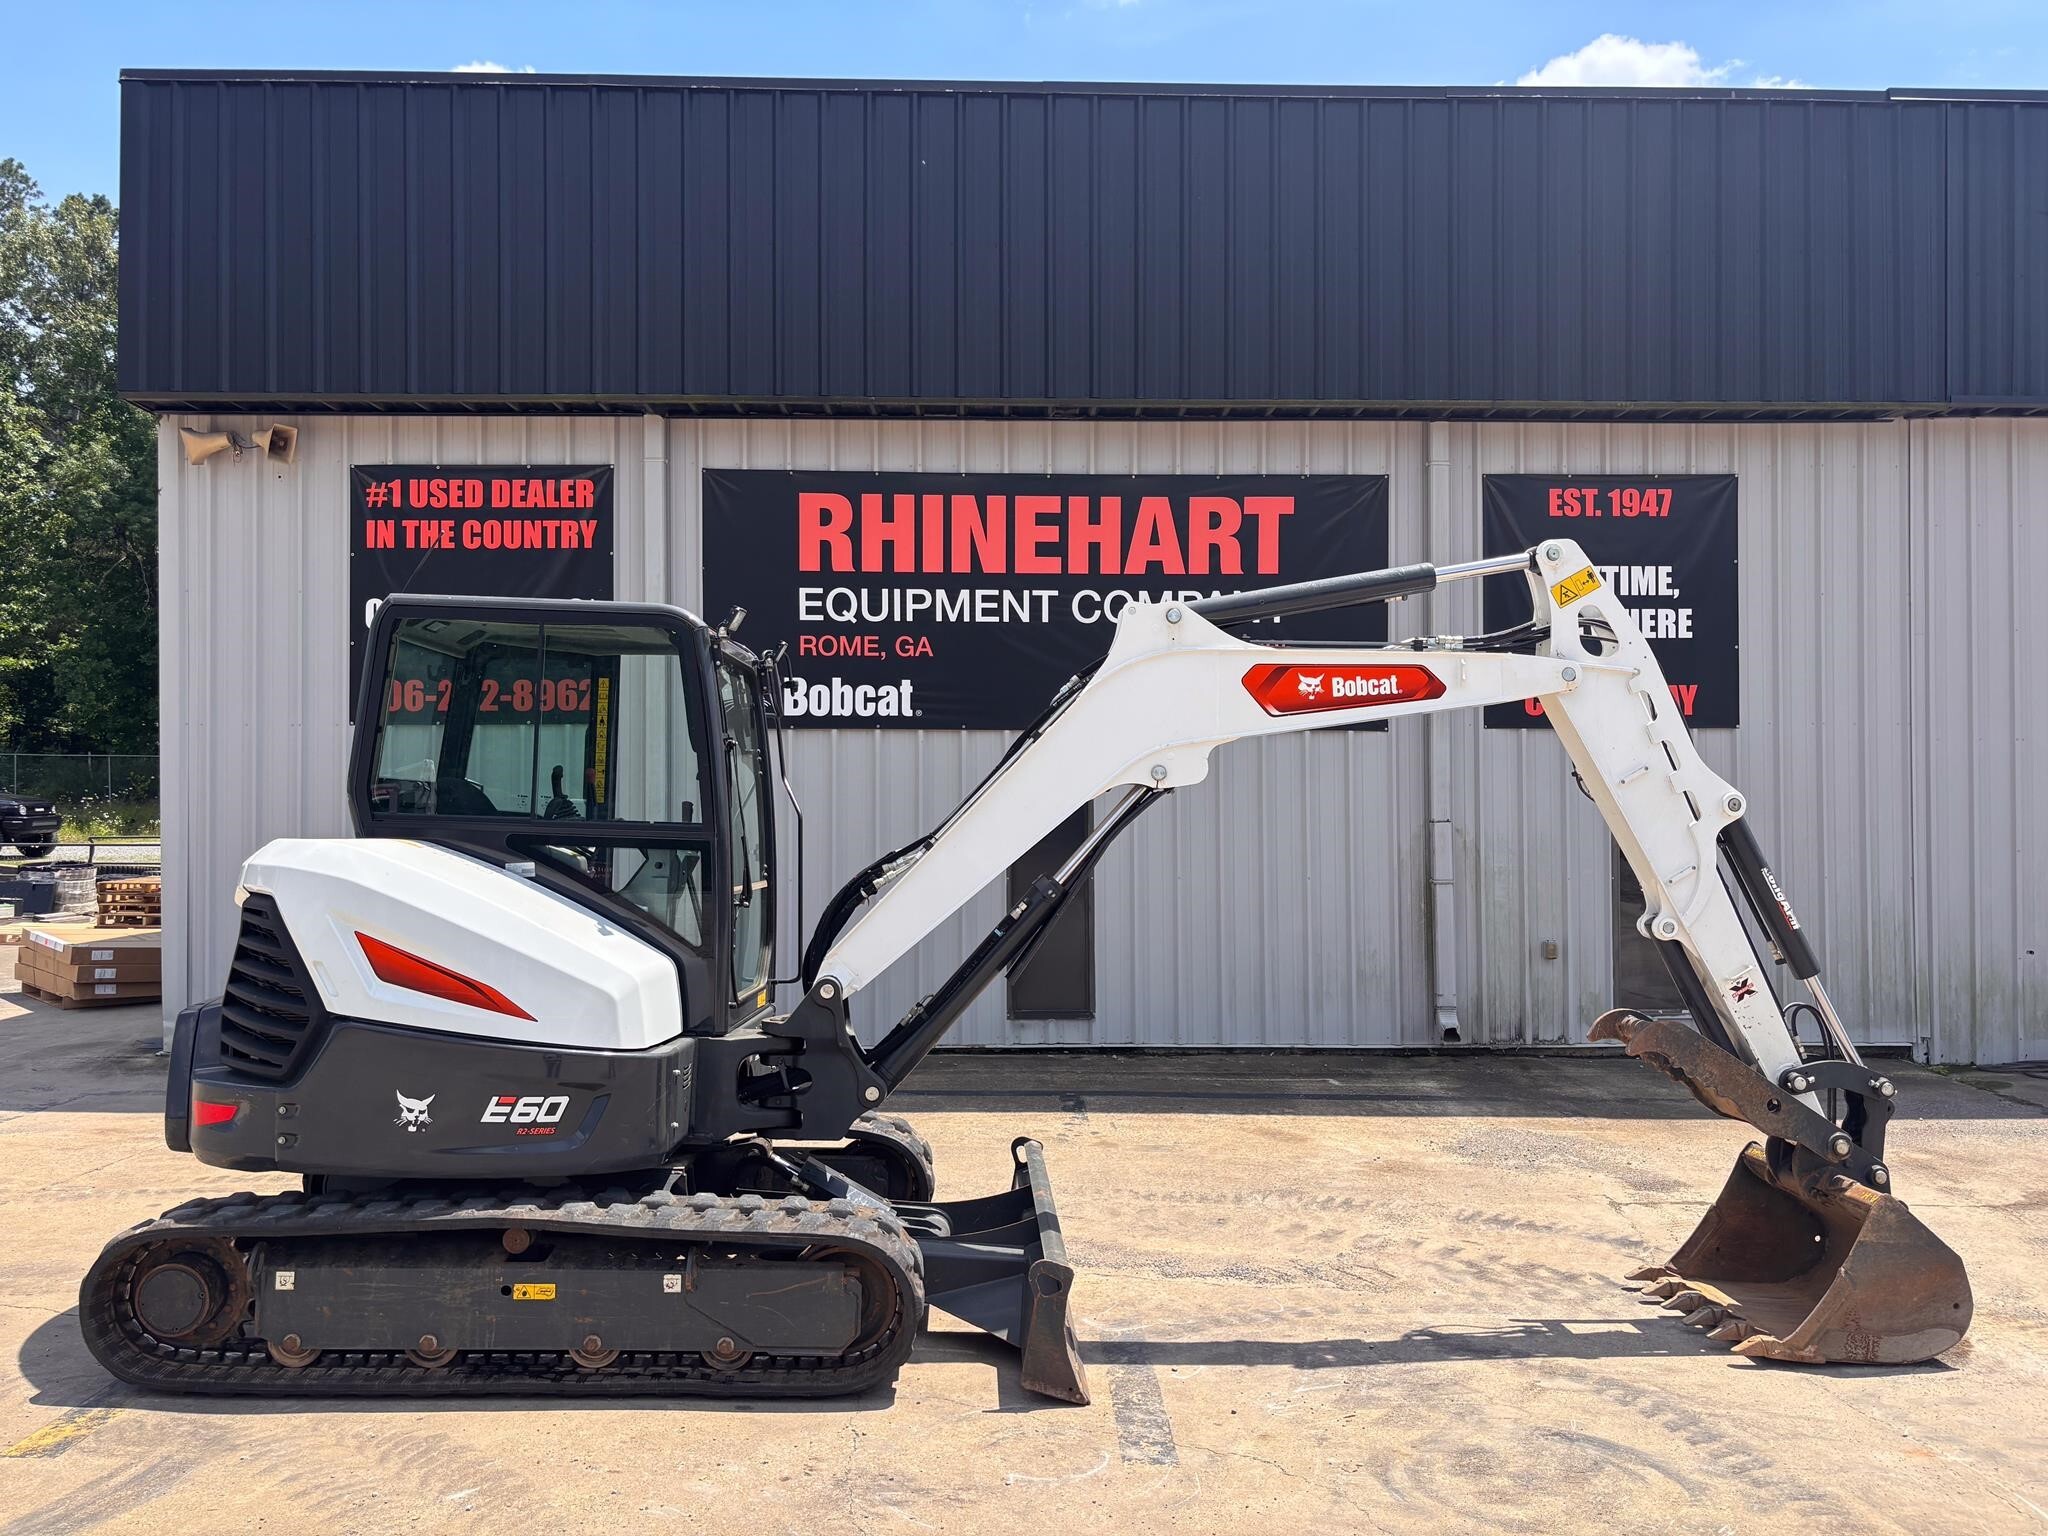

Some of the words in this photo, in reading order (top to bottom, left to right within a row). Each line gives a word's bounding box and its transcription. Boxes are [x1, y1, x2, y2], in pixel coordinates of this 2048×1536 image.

[366, 479, 401, 508] #1
[409, 479, 484, 508] USED
[491, 479, 595, 508] DEALER
[1549, 488, 1602, 517] EST.
[1607, 488, 1673, 517] 1947
[366, 519, 394, 549] IN
[402, 519, 455, 549] THE
[462, 519, 597, 549] COUNTRY
[798, 492, 1295, 575] RHINEHART
[1598, 565, 1680, 600] TIME,
[798, 587, 1059, 624] EQUIPMENT
[799, 635, 887, 661] ROME,
[895, 636, 934, 657] GA
[783, 677, 913, 717] Bobcat
[1332, 675, 1398, 697] Bobcat
[480, 1095, 570, 1123] E60
